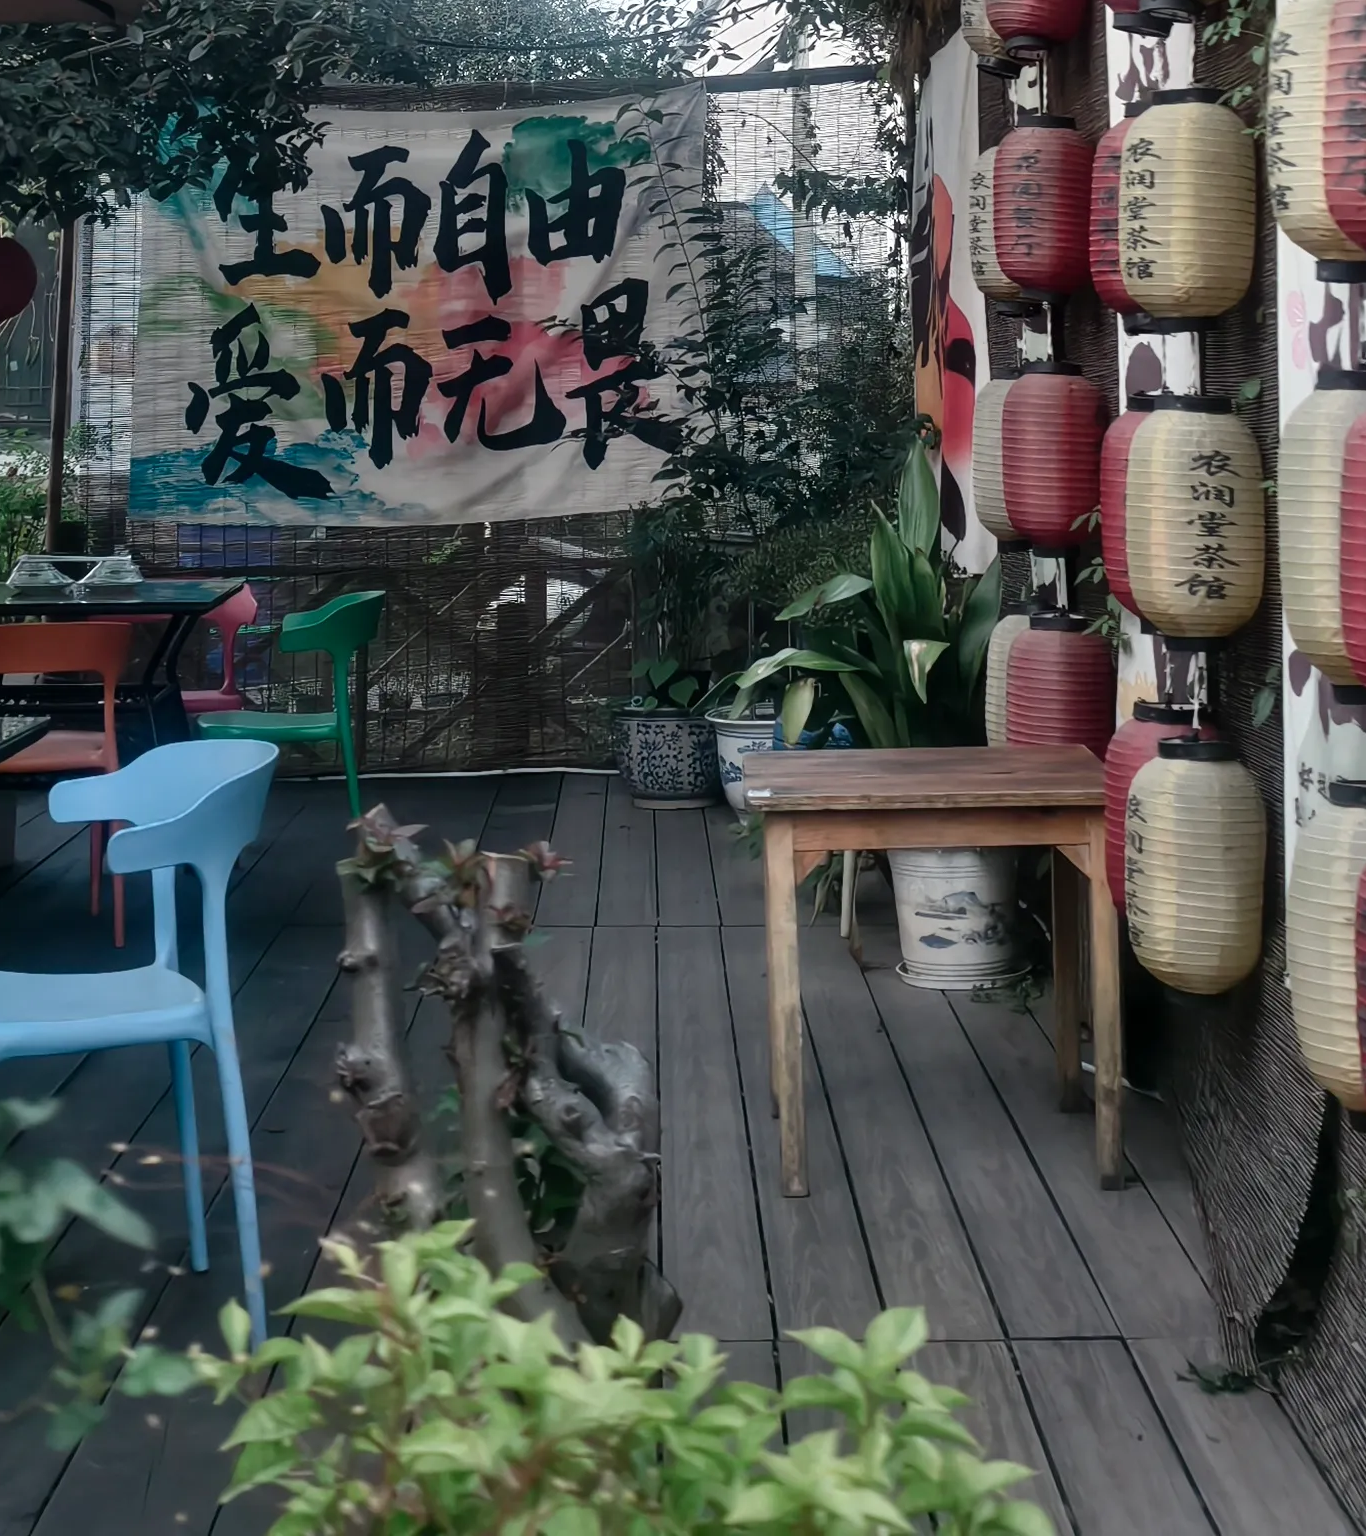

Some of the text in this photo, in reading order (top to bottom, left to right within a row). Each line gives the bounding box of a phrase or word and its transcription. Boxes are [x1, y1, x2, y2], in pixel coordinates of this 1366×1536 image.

[213, 128, 626, 304] 生而自由
[1123, 138, 1163, 280] 农润堂茶馆
[186, 277, 685, 500] 爱而无畏
[1174, 450, 1241, 600] 农润堂茶馆
